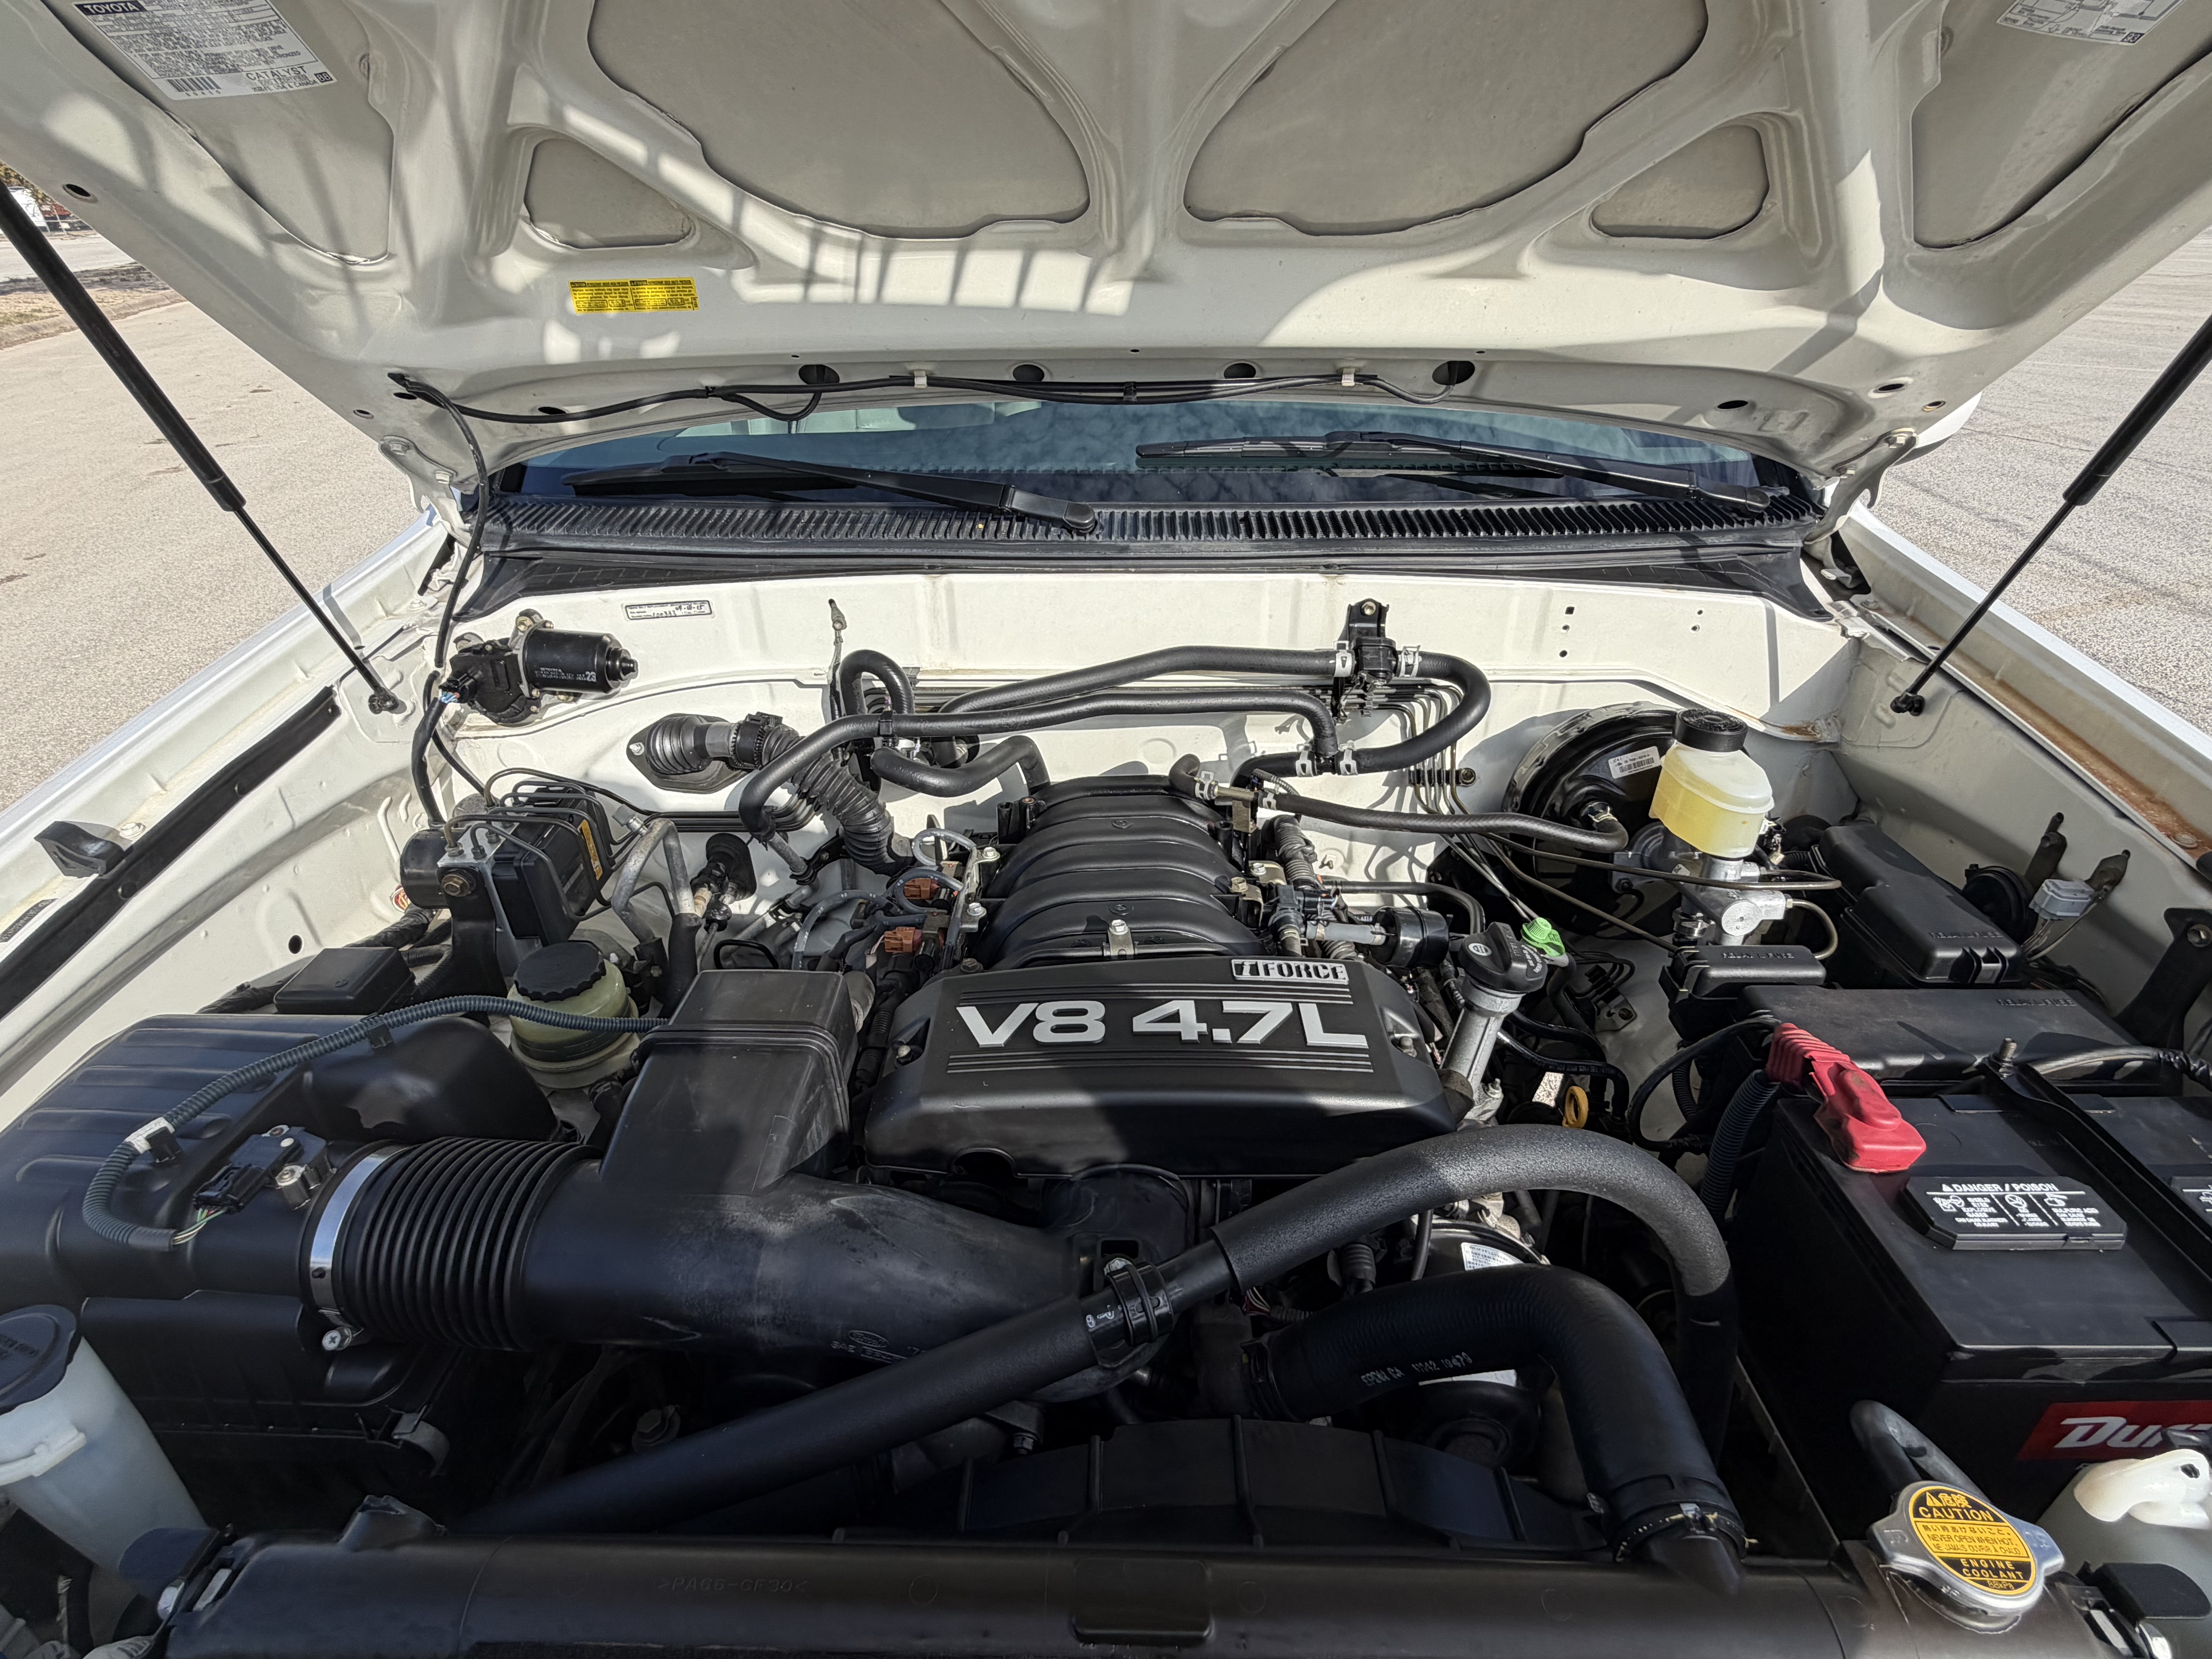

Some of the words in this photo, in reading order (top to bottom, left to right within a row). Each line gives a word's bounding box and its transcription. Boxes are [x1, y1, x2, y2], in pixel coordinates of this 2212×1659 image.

[83, 2, 140, 14] TOYOTA
[246, 66, 307, 81] CATALYST
[957, 1001, 1106, 1048] V8
[1132, 1000, 1369, 1049] 4.7L
[1951, 1183, 2004, 1192] DANGER
[2011, 1183, 2059, 1191] POISON
[1938, 1493, 1972, 1508] 危険
[1918, 1507, 1994, 1522] CAUTION
[1927, 1534, 1954, 1542] NEVER
[1955, 1535, 1976, 1544] OPEN
[1976, 1536, 1998, 1545] WHEN
[1960, 1558, 2015, 1570] ENGINE
[1962, 1568, 2024, 1580] COOLANT
[1987, 1580, 2015, 1590] 88kPa
